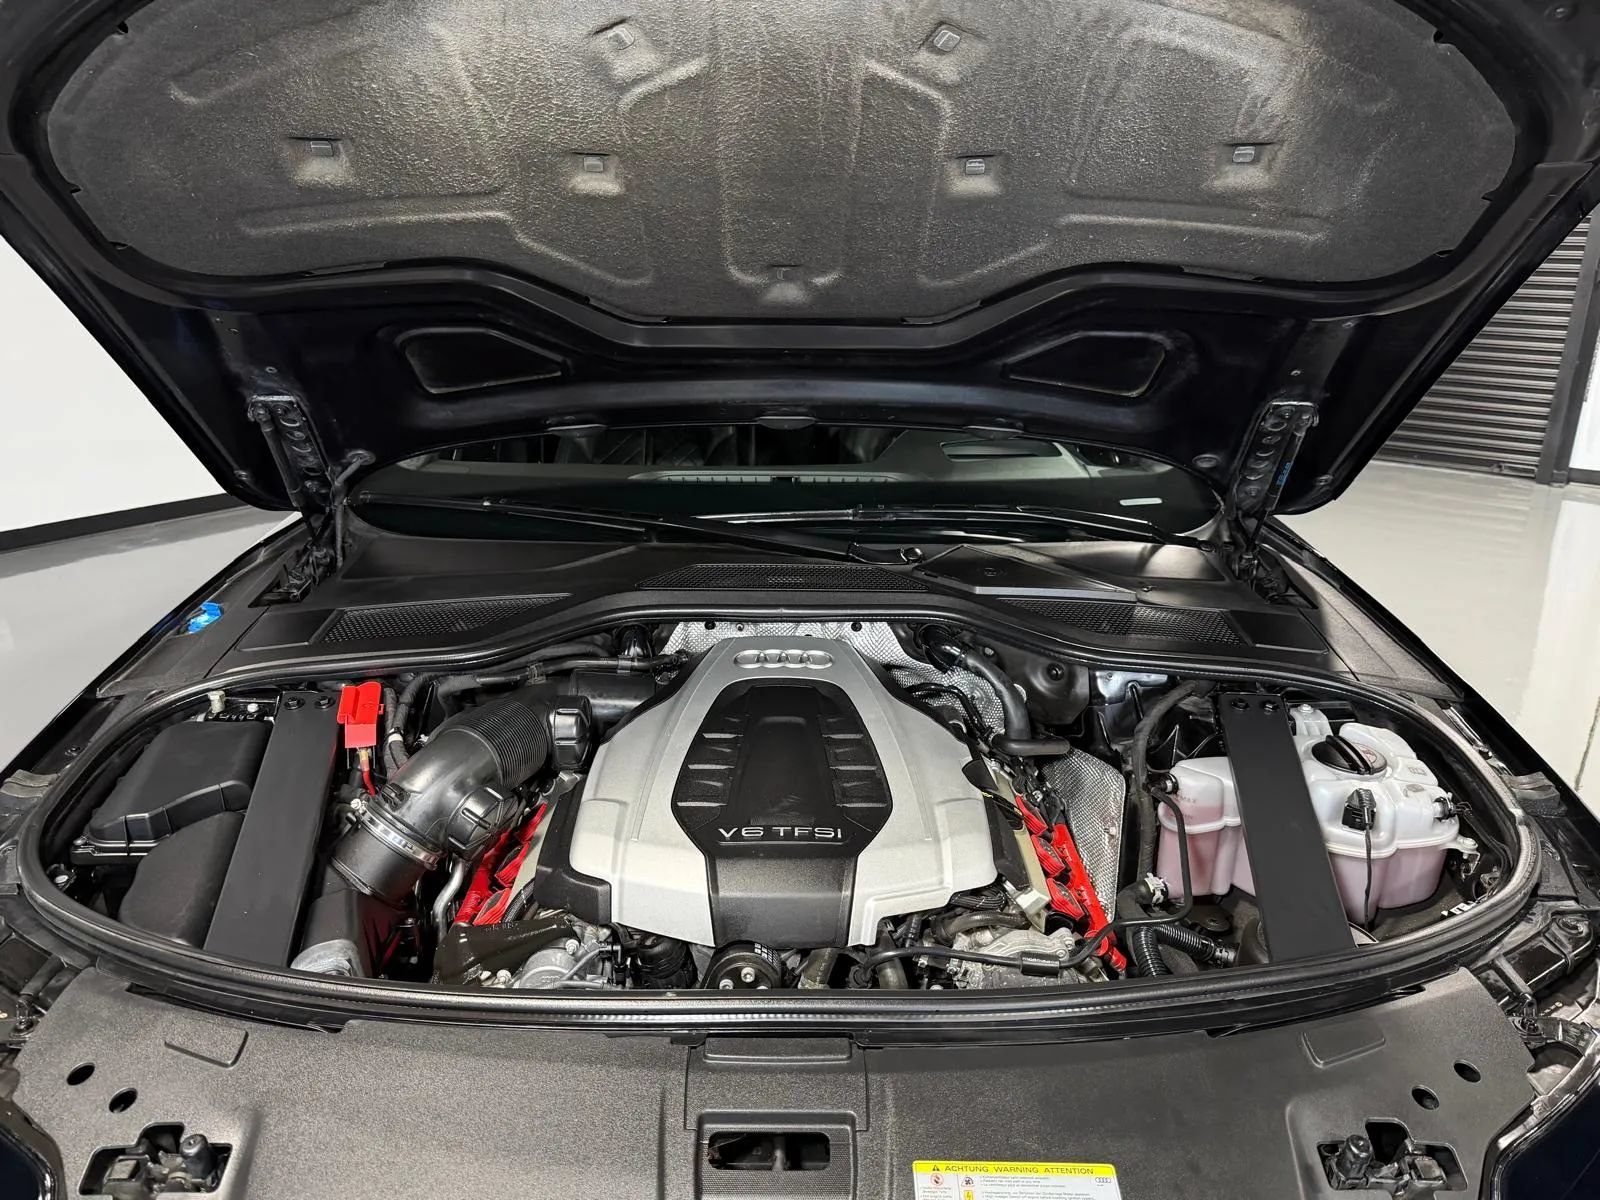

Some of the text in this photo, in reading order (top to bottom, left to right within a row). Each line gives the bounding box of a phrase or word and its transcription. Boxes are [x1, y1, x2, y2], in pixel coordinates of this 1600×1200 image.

[718, 826, 842, 839] V6 TFSI
[944, 1165, 1094, 1175] ACHTUNG WARNING ATTENTION
